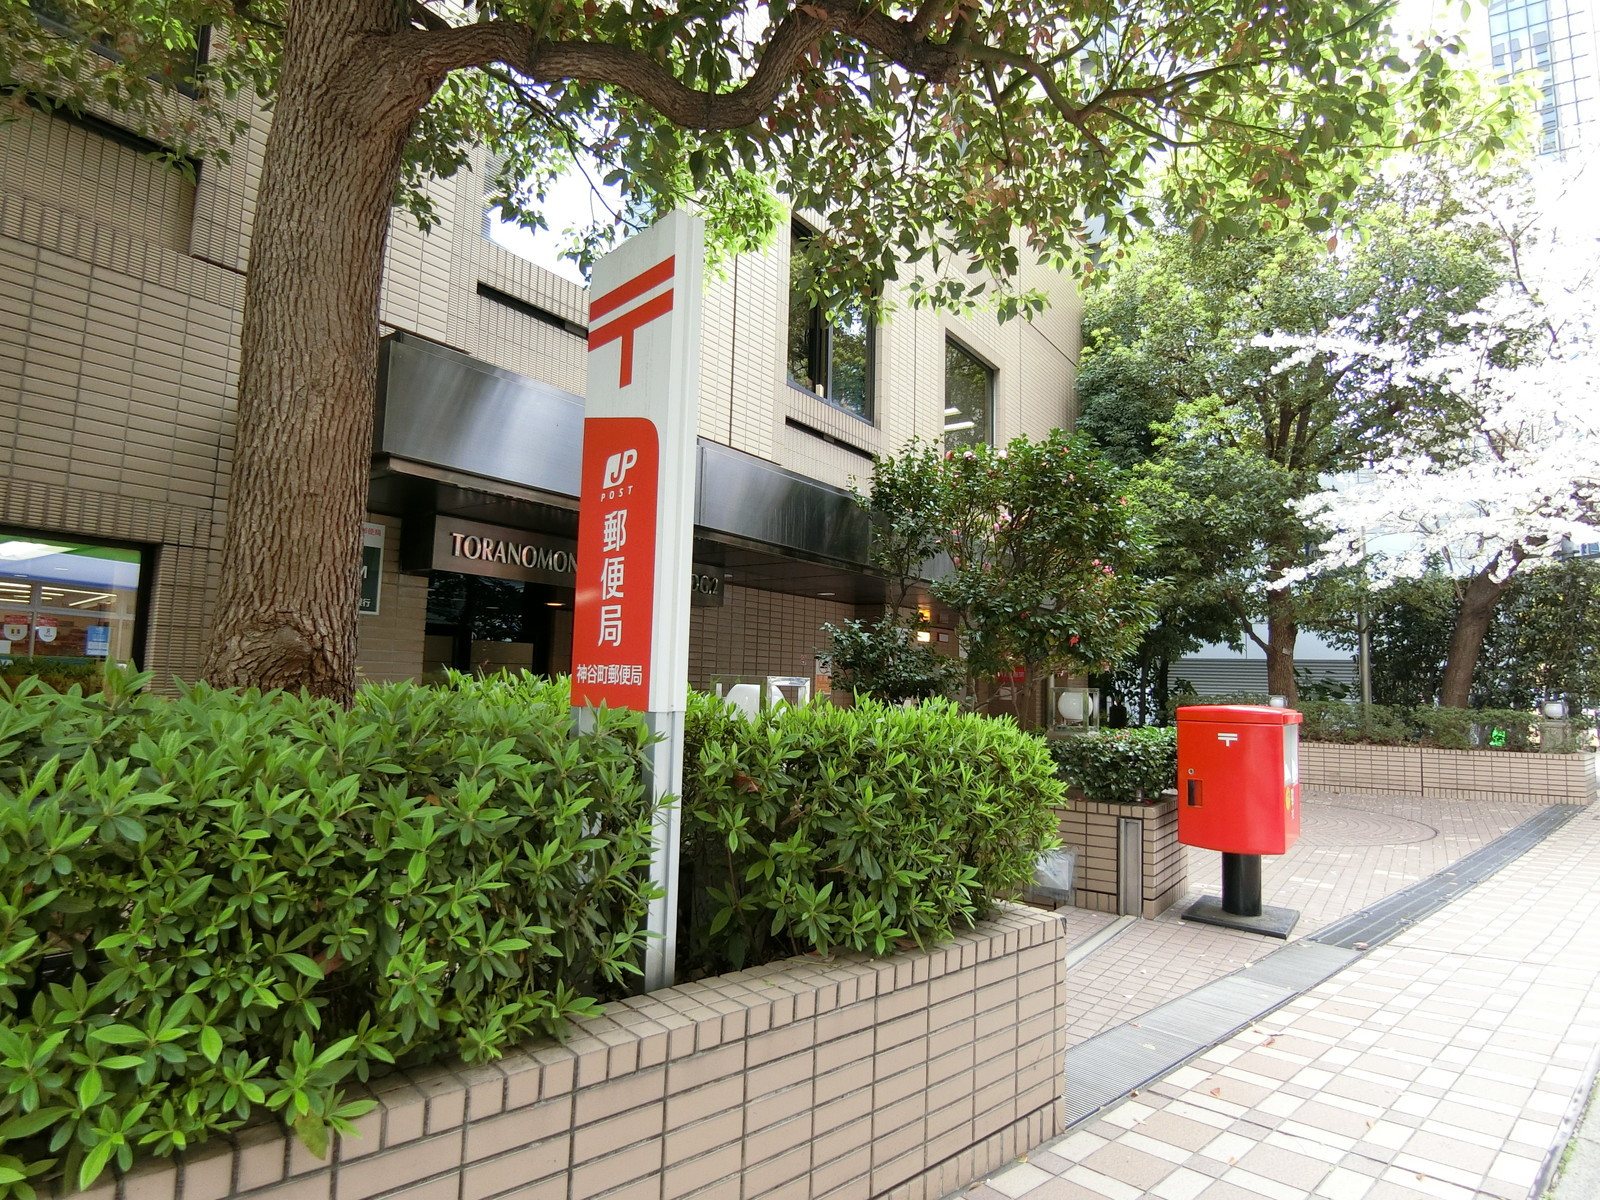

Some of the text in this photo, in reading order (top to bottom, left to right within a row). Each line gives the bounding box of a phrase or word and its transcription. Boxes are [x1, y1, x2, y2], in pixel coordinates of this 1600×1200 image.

[600, 485, 634, 503] POST
[451, 532, 578, 574] TORANOMON
[597, 508, 628, 647] 郵便局
[576, 664, 643, 686] 神谷町郵便局
